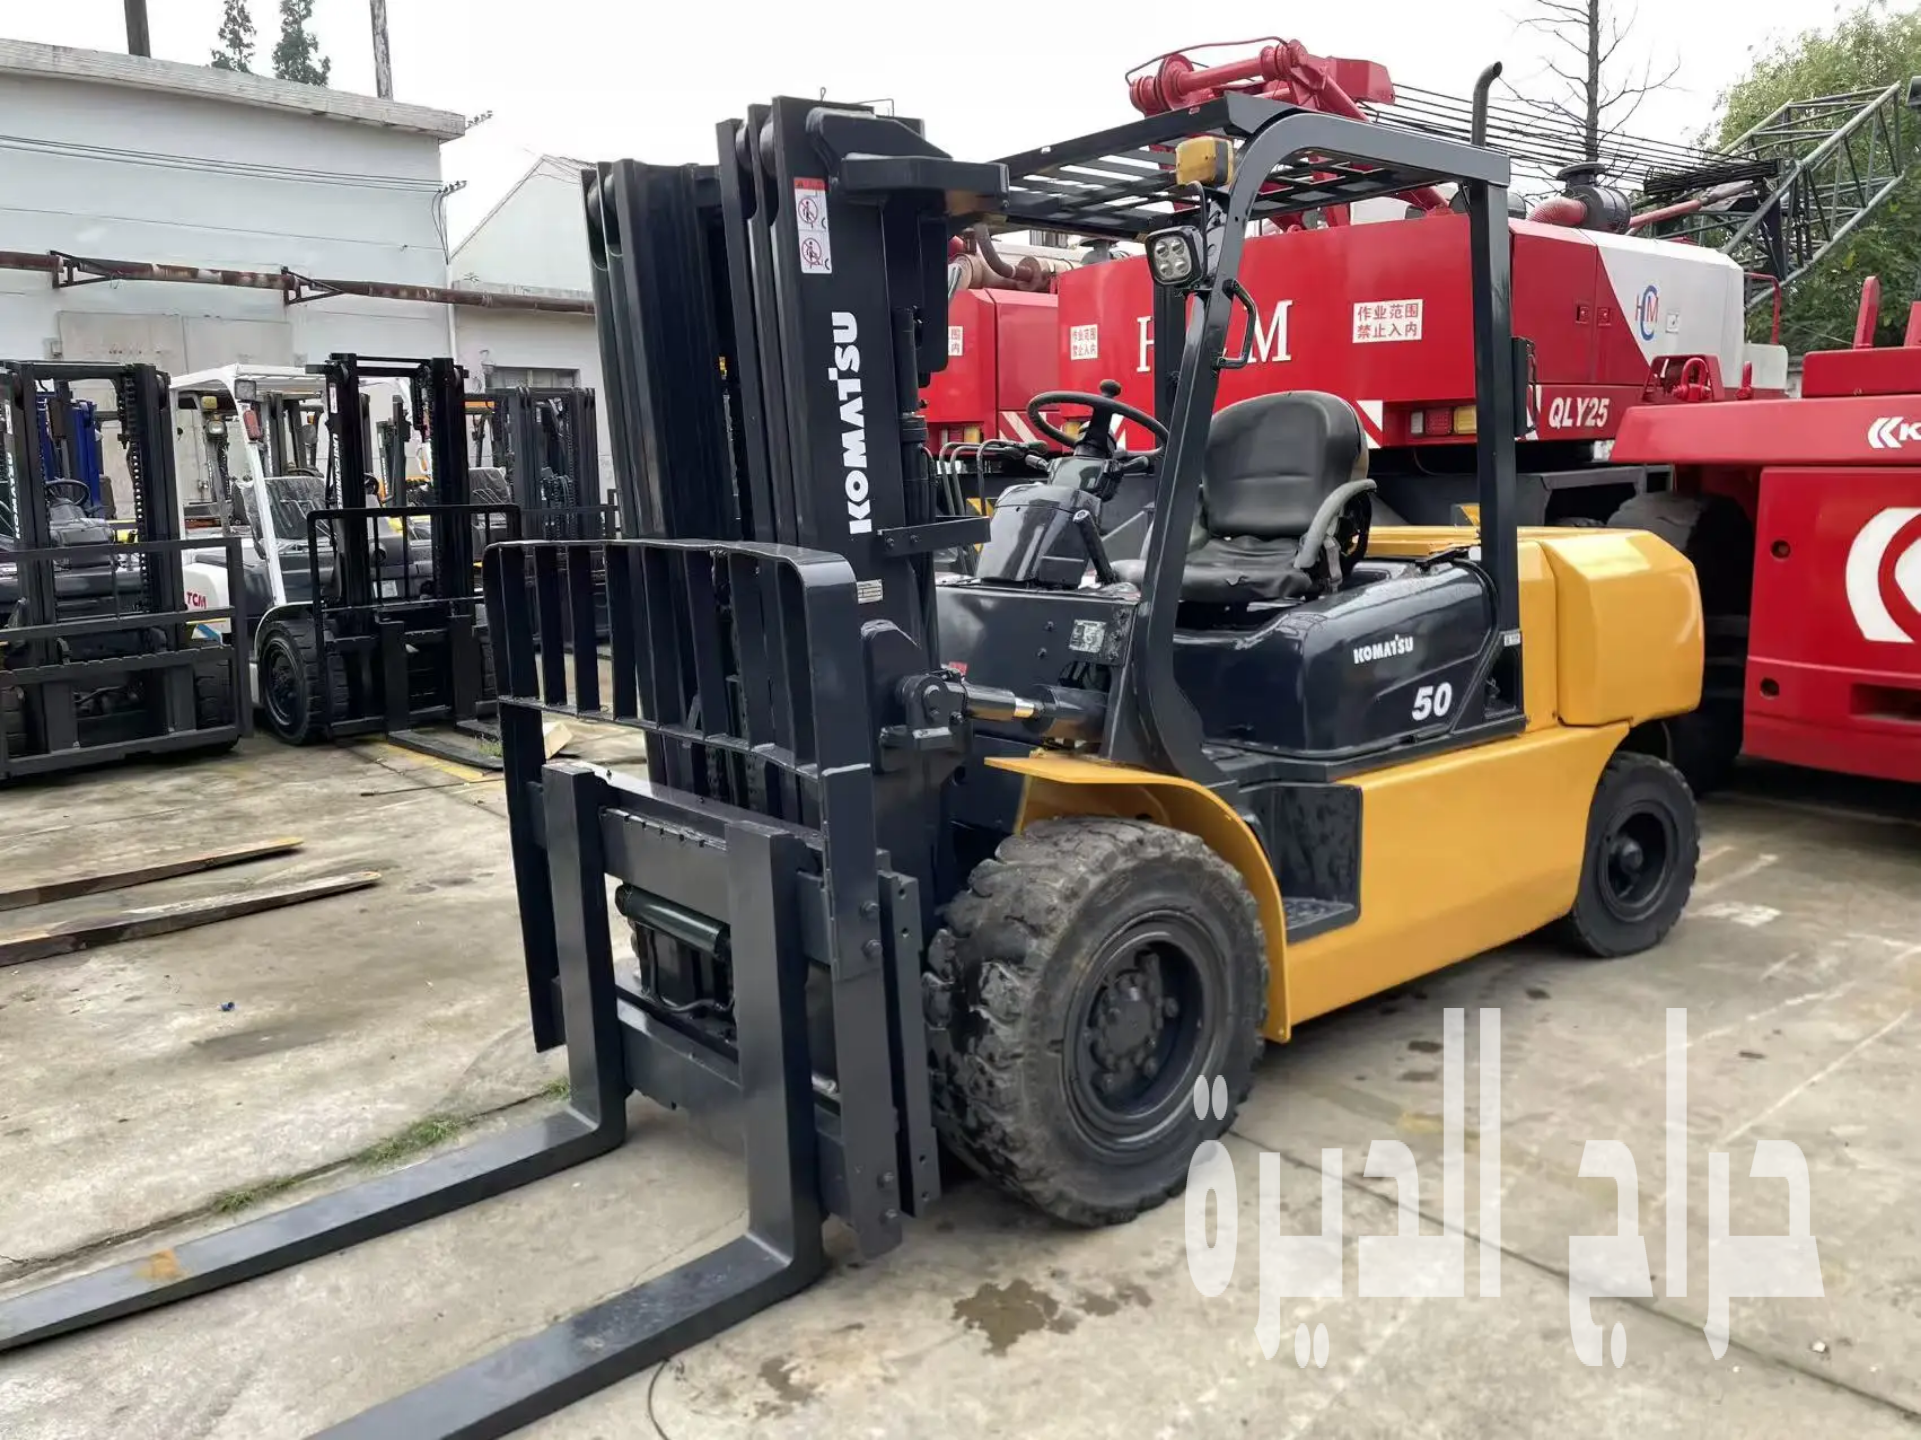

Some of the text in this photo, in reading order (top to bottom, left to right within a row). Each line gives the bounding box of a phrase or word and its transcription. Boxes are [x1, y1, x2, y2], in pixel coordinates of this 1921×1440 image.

[1357, 303, 1419, 321] 作业范围
[1357, 321, 1418, 339] 禁止入内
[828, 312, 872, 534] KOMATSU
[1549, 397, 1610, 429] QLY25
[186, 591, 207, 609] TCM
[1353, 634, 1414, 664] KOMATSU
[1411, 681, 1452, 721] 50
